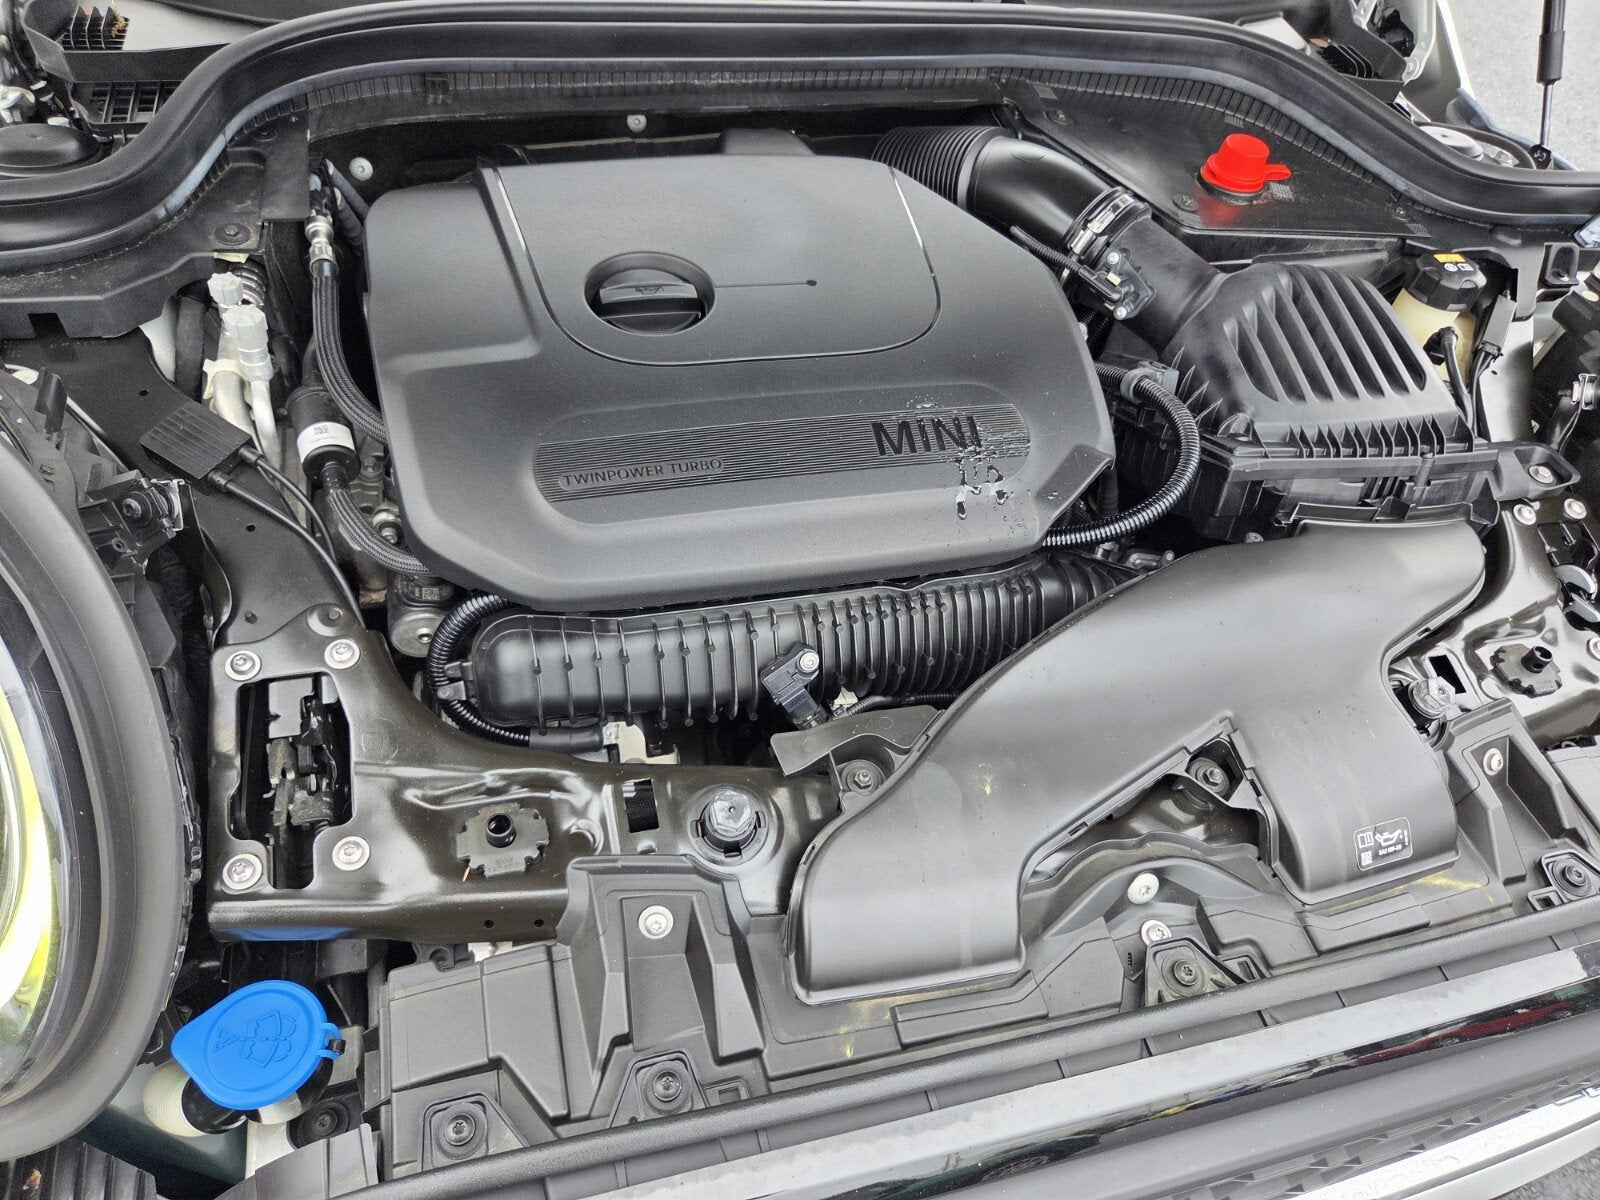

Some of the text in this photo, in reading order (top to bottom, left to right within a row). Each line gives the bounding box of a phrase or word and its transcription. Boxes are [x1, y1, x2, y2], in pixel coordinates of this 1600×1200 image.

[871, 415, 982, 456] MINI
[563, 458, 722, 486] TWINPOWER TURBO
